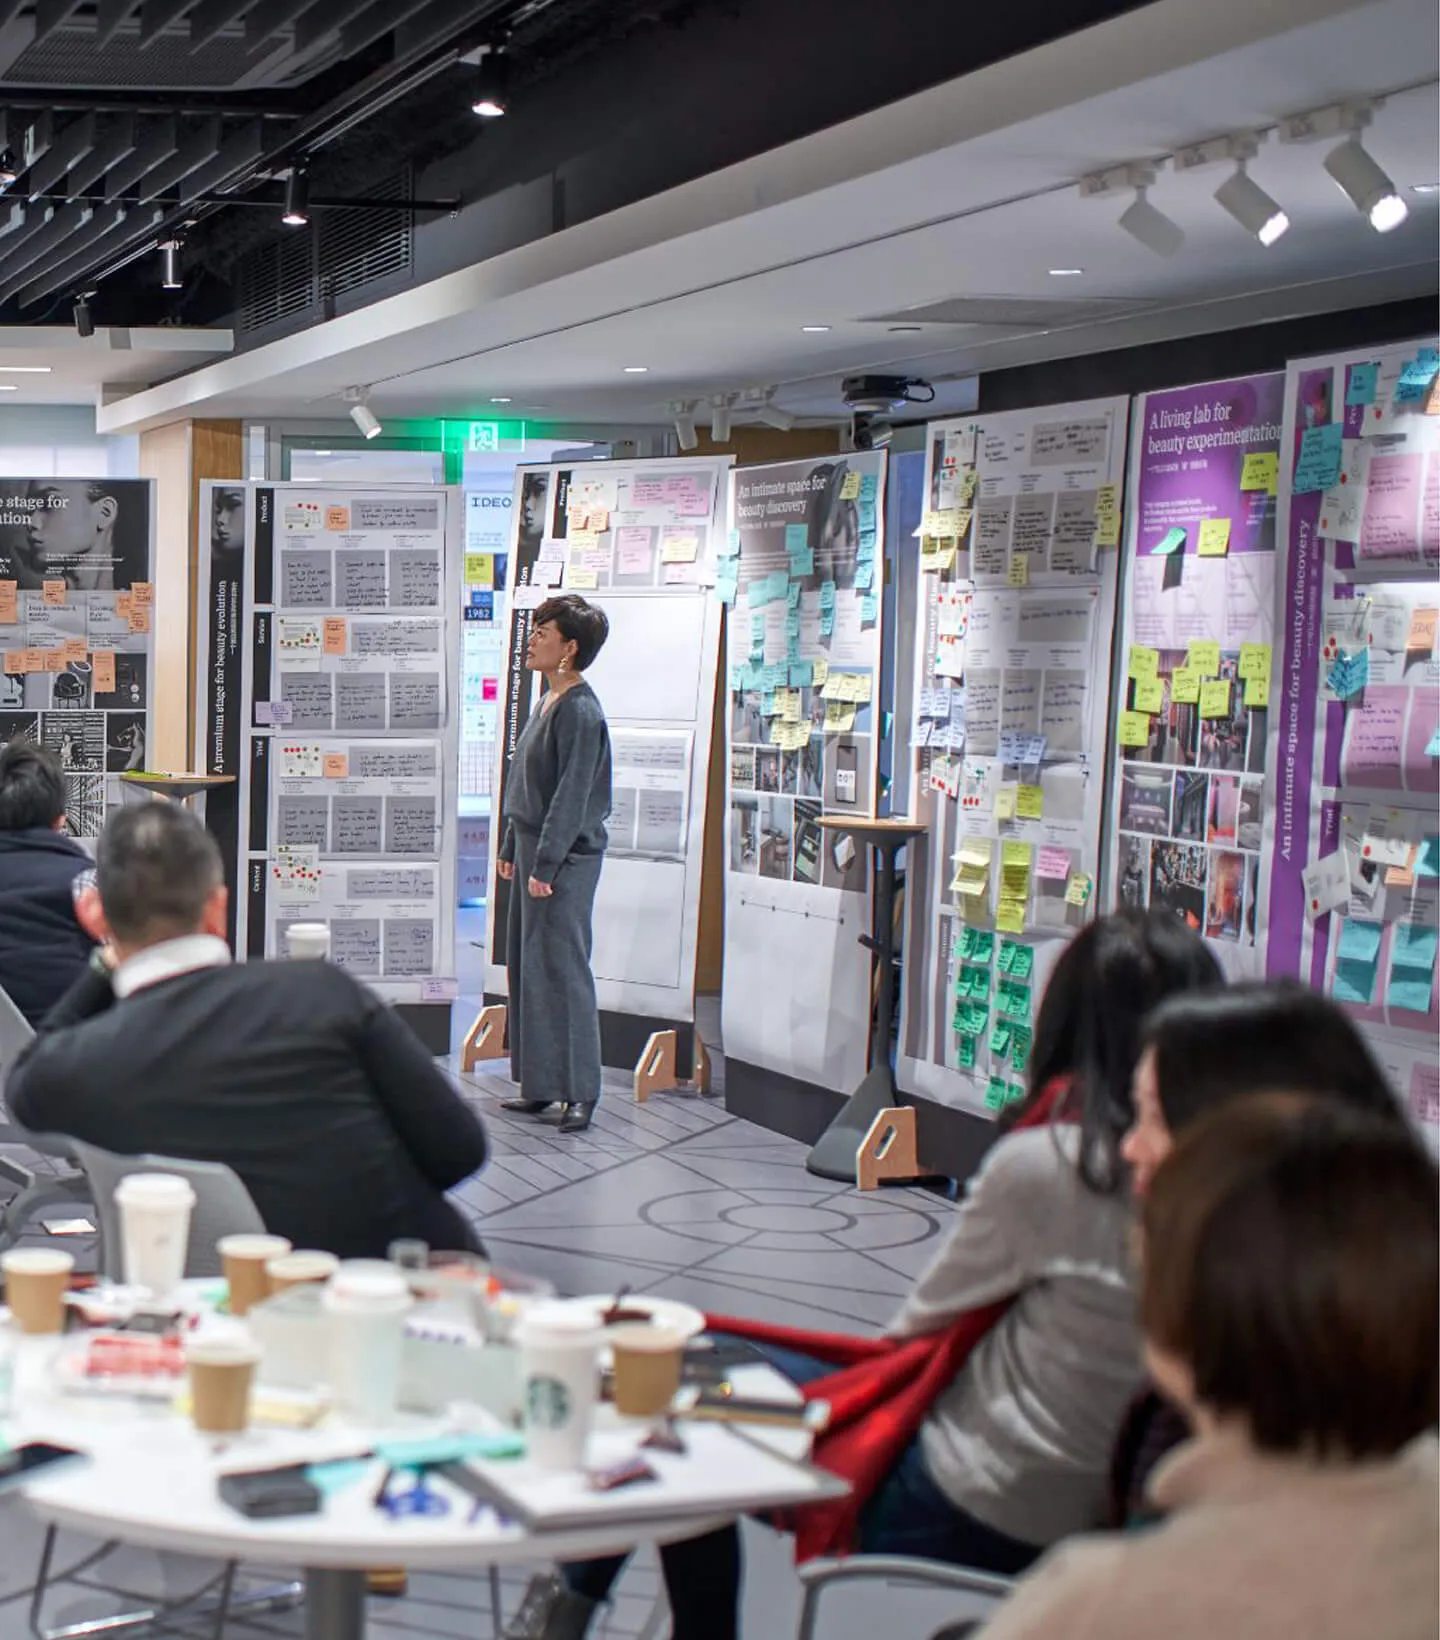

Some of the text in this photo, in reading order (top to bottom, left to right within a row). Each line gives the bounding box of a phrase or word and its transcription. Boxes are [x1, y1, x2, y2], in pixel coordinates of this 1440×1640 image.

[1150, 401, 1232, 430] A living lab for
[1148, 435, 1185, 455] beauty
[739, 474, 827, 498] An intimate space for
[6, 495, 45, 510] stage
[47, 494, 69, 508] for
[471, 497, 512, 508] IDEO
[738, 503, 766, 518] beauty
[1294, 520, 1310, 606] discovery
[467, 608, 490, 618] 1982
[514, 618, 526, 652] beauty
[1291, 610, 1306, 671] beauty
[513, 654, 522, 671] for
[213, 580, 227, 774] A premium stage for beauty evolution
[512, 673, 522, 699] stage
[1287, 674, 1301, 699] for
[508, 703, 519, 751] premium
[1287, 701, 1301, 754] space
[1282, 756, 1296, 832] intimate
